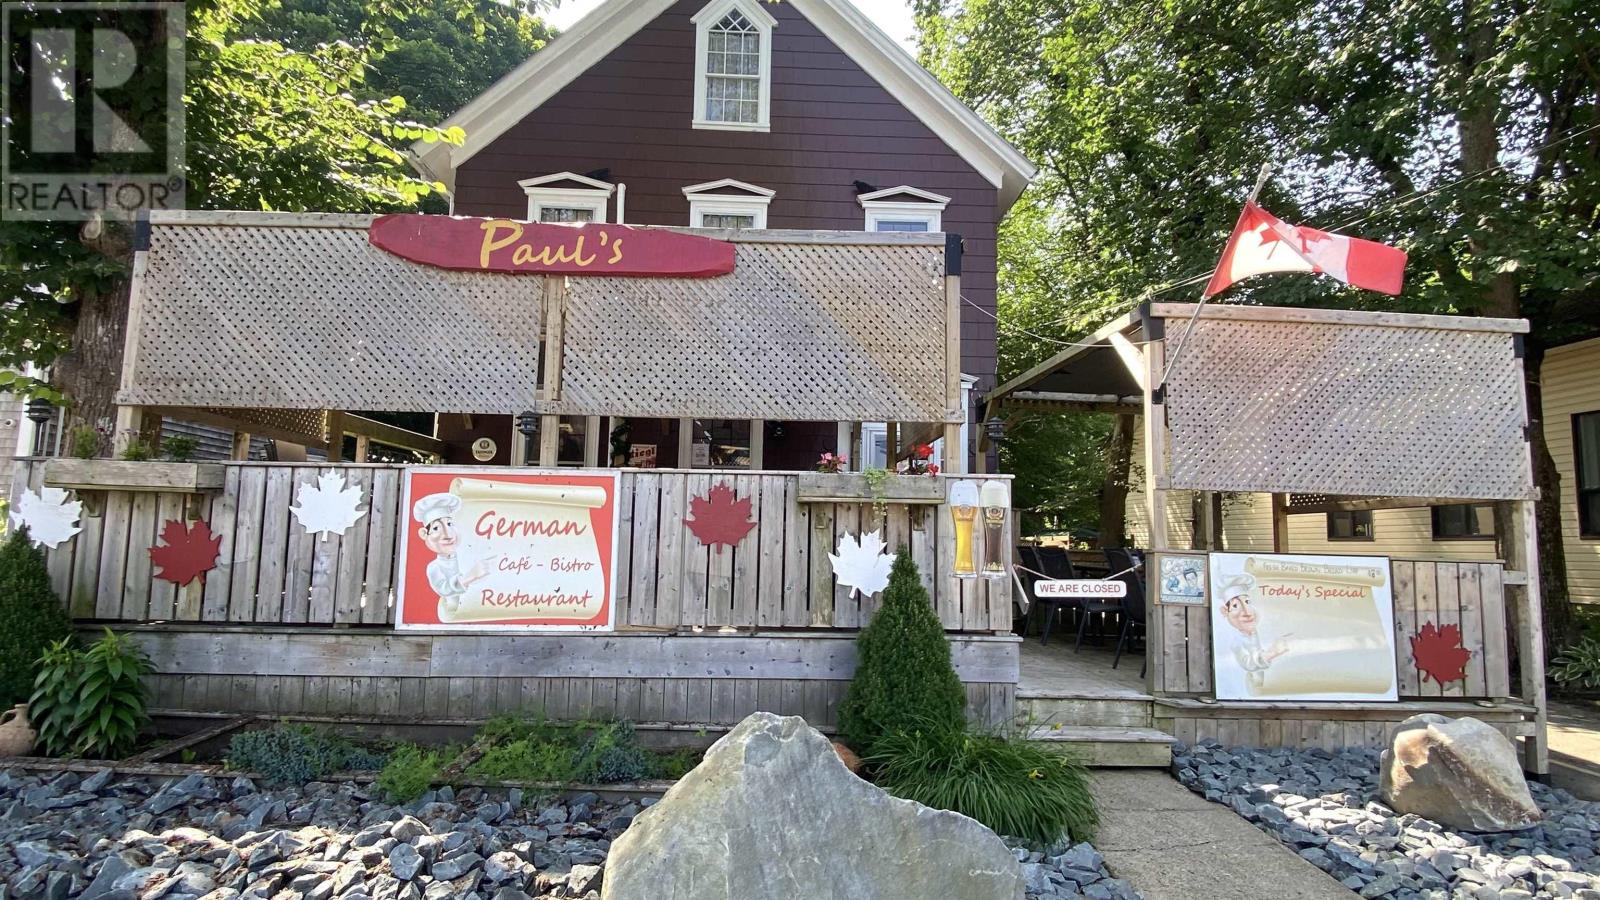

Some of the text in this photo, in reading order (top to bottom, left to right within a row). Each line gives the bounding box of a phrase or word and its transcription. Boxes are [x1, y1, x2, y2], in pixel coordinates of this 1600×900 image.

[480, 219, 623, 268] Paul's
[475, 510, 587, 539] German
[498, 557, 531, 574] Café
[550, 557, 594, 572] Bistro
[1040, 584, 1121, 593] WE ARE CLOSED
[1258, 585, 1366, 600] Today's Special
[481, 589, 593, 608] Restaurant
